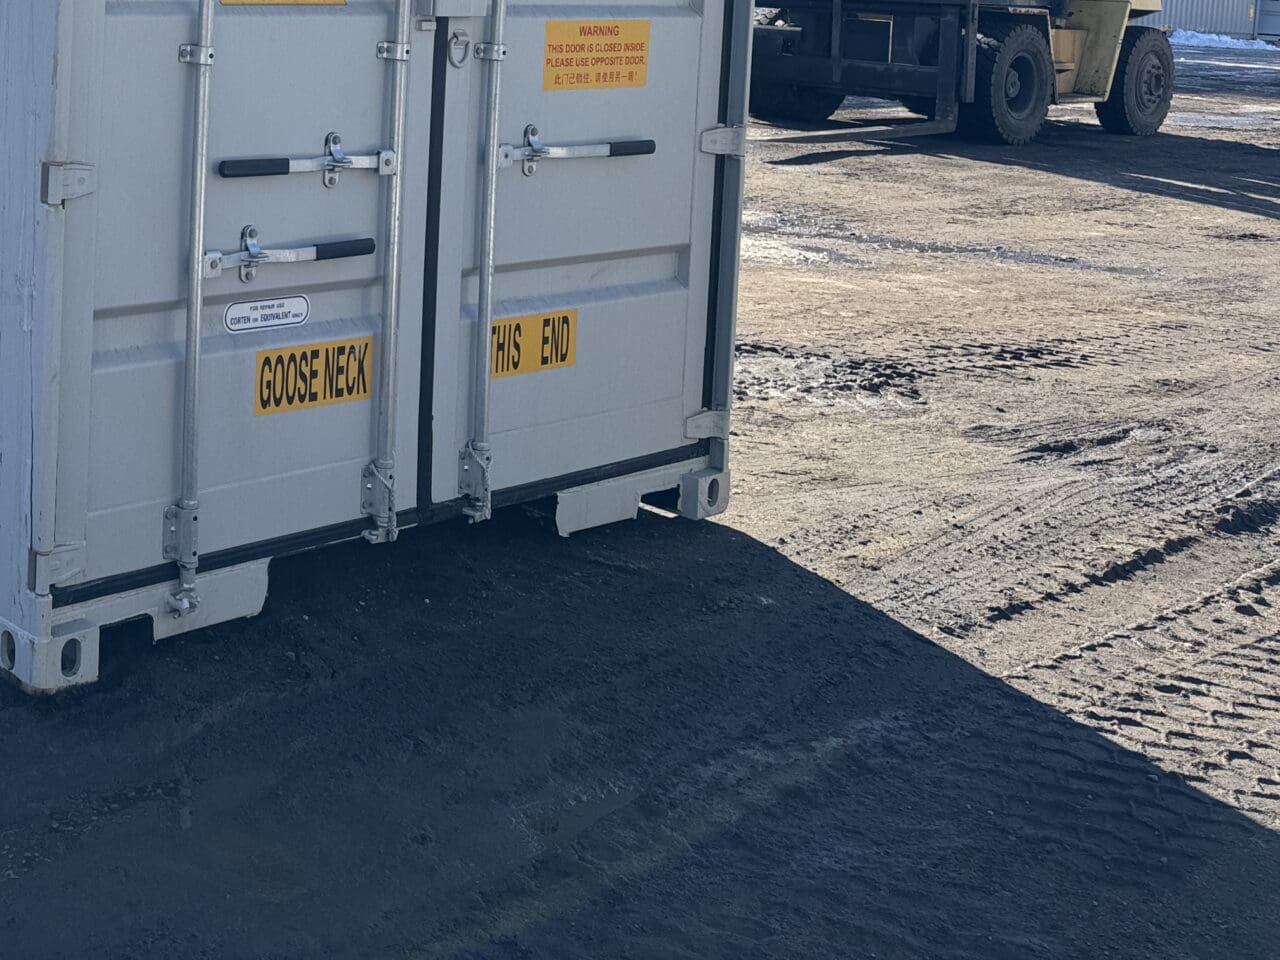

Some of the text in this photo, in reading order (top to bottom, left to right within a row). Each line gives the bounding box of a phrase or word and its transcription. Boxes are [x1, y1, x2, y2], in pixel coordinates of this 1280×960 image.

[579, 25, 620, 37] WARNING
[548, 44, 563, 53] THIS
[565, 43, 585, 53] DOOR
[586, 43, 594, 53] IS
[595, 42, 622, 52] CLOSED
[546, 58, 574, 67] PLEASE
[575, 57, 590, 67] USE
[590, 56, 624, 66] OPPOSITE
[230, 315, 251, 326] CORTEN
[260, 311, 291, 322] EQUIVALENT
[541, 315, 570, 365] END
[259, 342, 369, 410] GOOSE NECK
